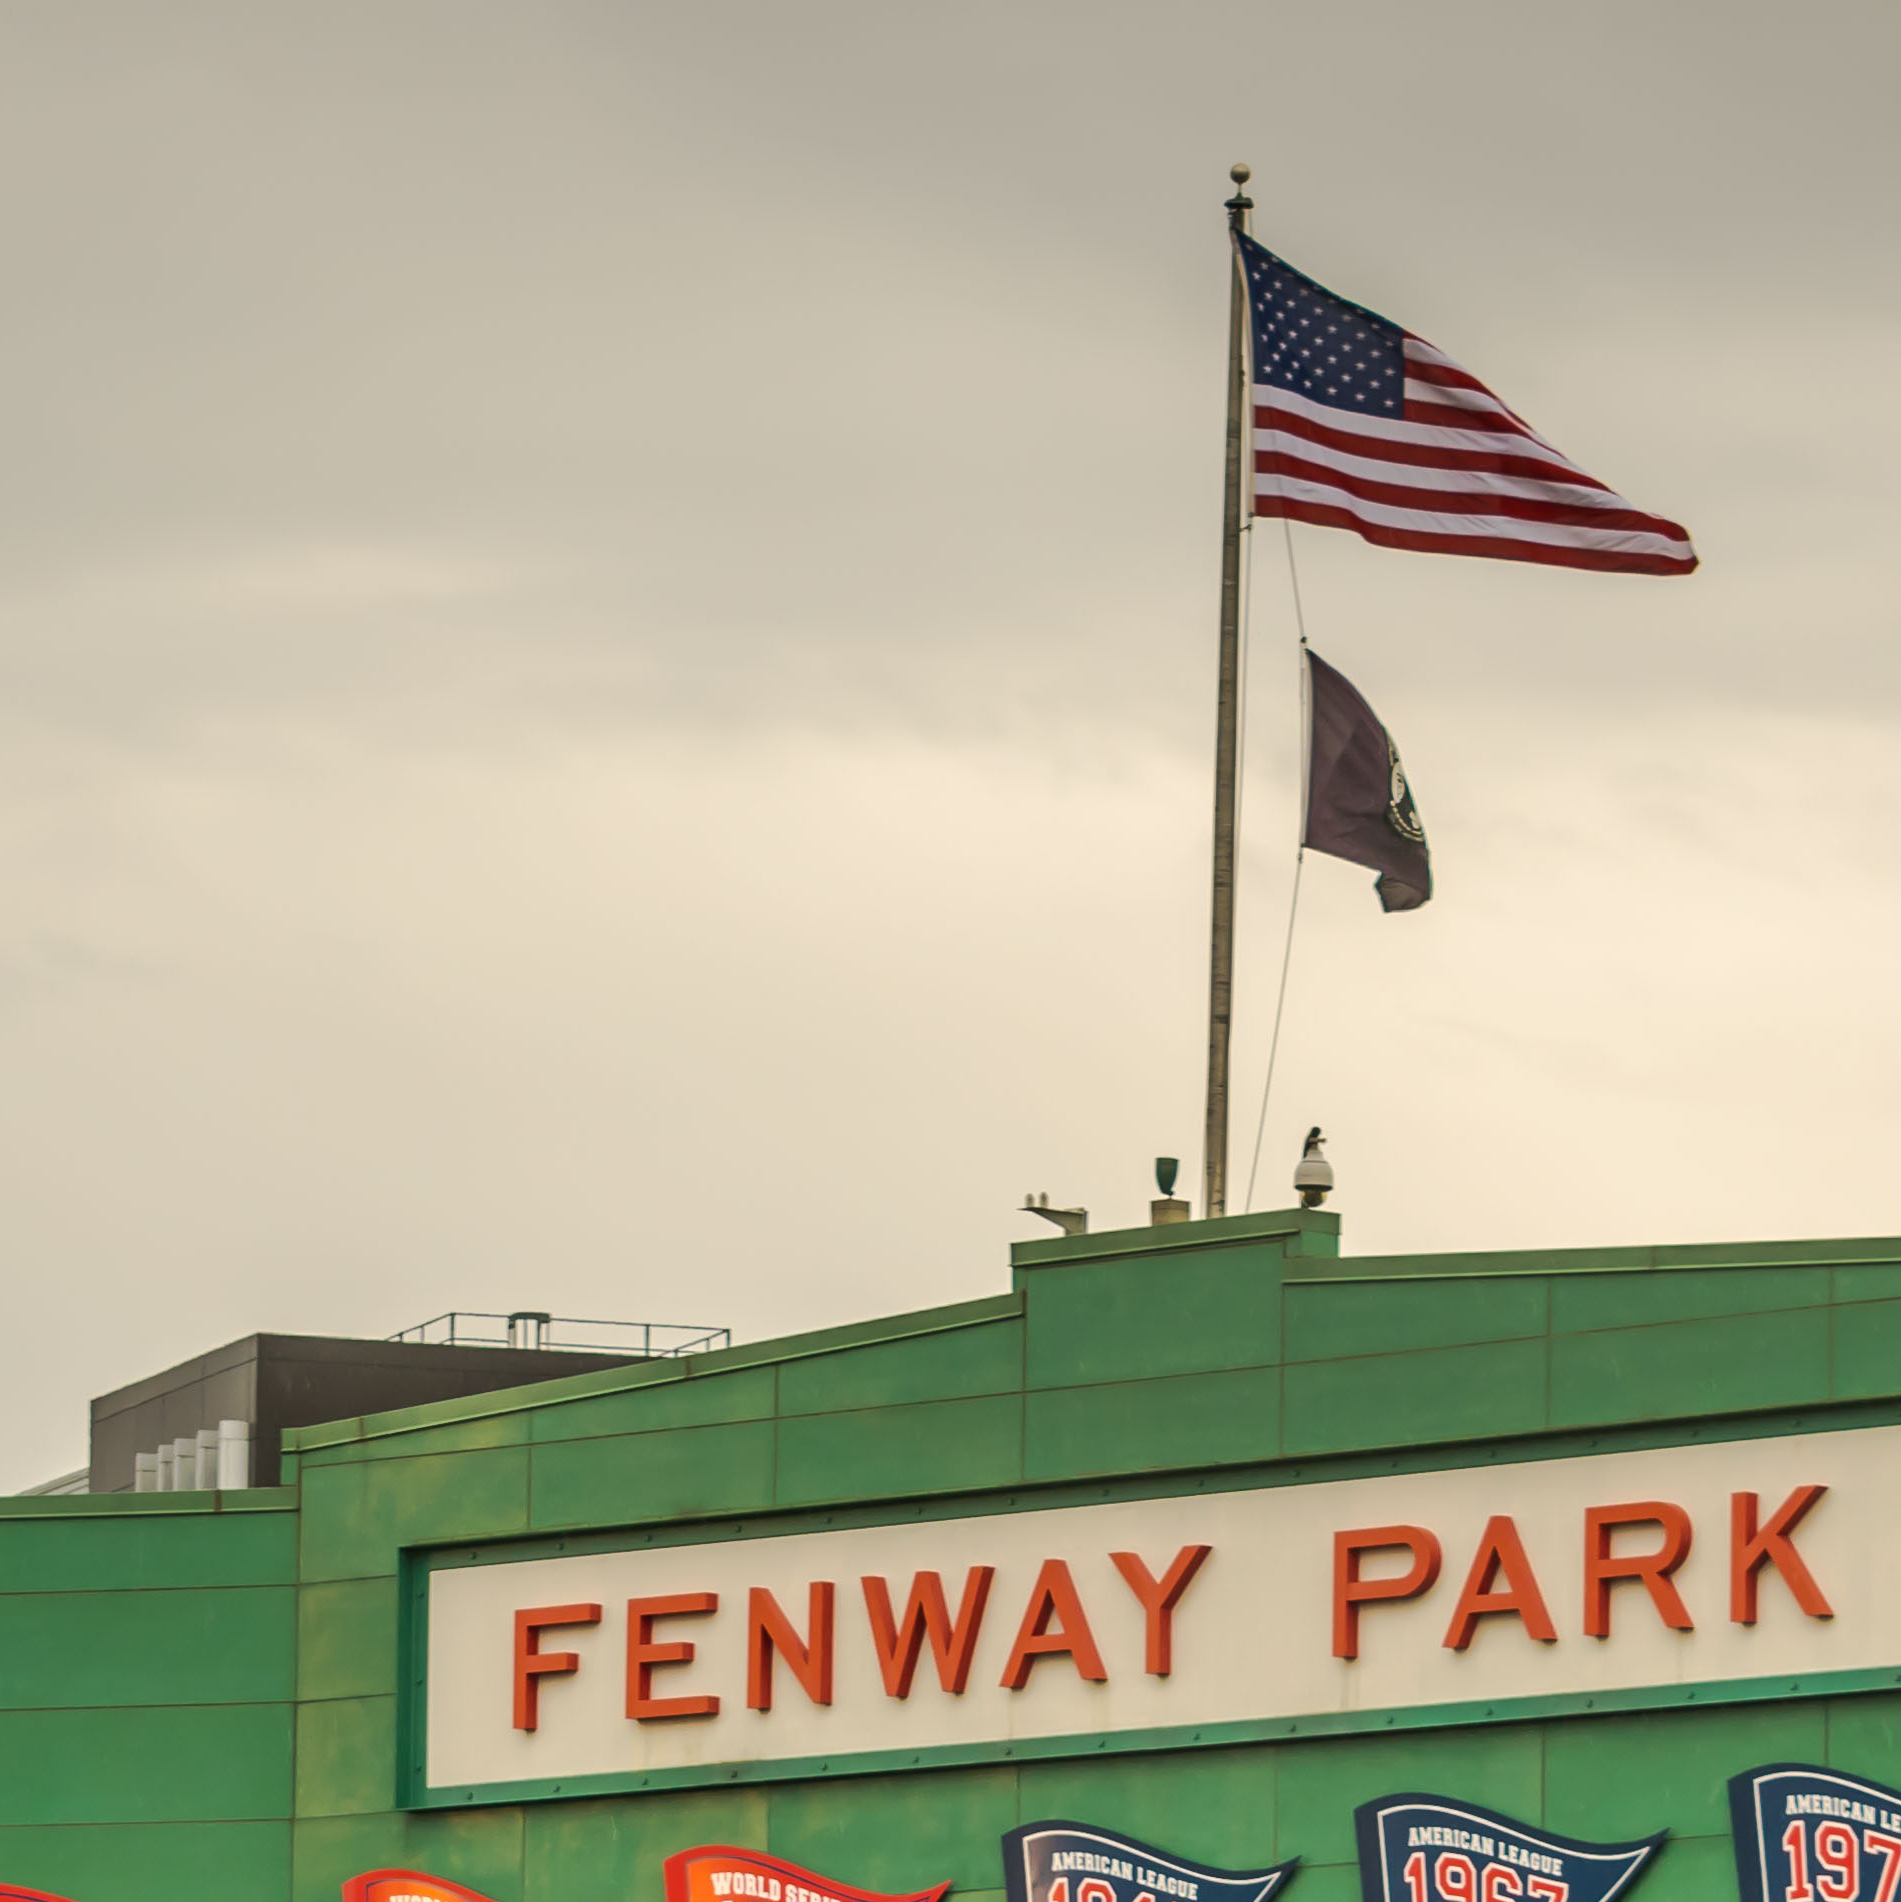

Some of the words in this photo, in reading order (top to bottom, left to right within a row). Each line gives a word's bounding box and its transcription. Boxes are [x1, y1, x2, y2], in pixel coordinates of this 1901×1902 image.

[512, 1543, 1213, 1732] FENWAY
[1331, 1484, 1836, 1660] PARK
[1785, 1794, 1876, 1823] AMERICAN
[1051, 1851, 1132, 1882] AMERICAN
[1136, 1868, 1199, 1900] LEAGUE
[1408, 1826, 1493, 1856] AMERICAN
[1497, 1844, 1563, 1876] LEAGUE
[711, 1871, 782, 1902] WORLD
